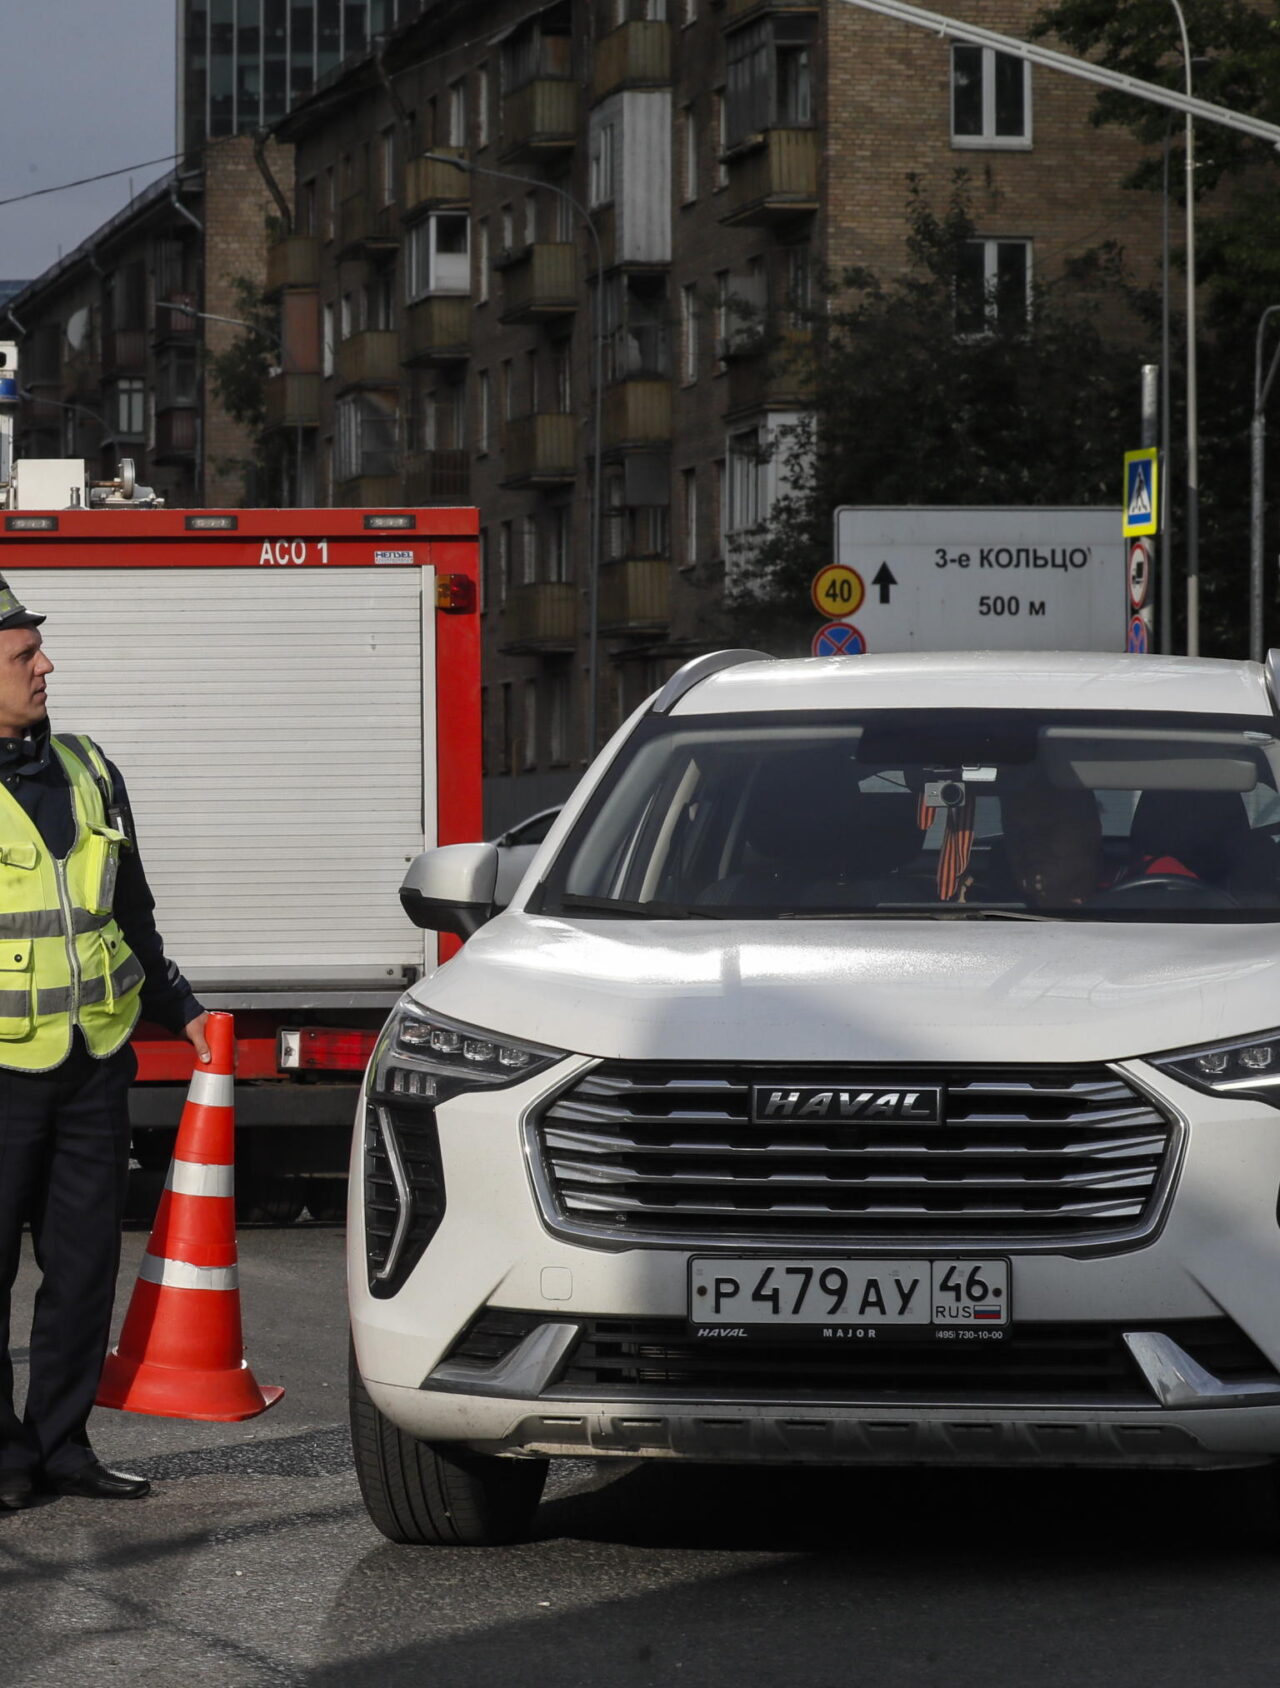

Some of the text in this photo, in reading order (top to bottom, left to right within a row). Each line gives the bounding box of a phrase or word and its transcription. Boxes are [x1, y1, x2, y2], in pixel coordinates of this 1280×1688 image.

[259, 538, 329, 565] АСО 1
[935, 548, 1088, 572] 3-е КОЛЬЦО
[825, 579, 852, 602] 40
[978, 596, 1046, 616] 500 м
[764, 1091, 930, 1116] HAVAL
[939, 1265, 989, 1302] 46
[935, 1305, 972, 1318] RUS
[697, 1328, 748, 1337] HAVAL
[823, 1328, 876, 1338] MAJOR
[935, 1330, 1004, 1340] (495) 730-10-00
